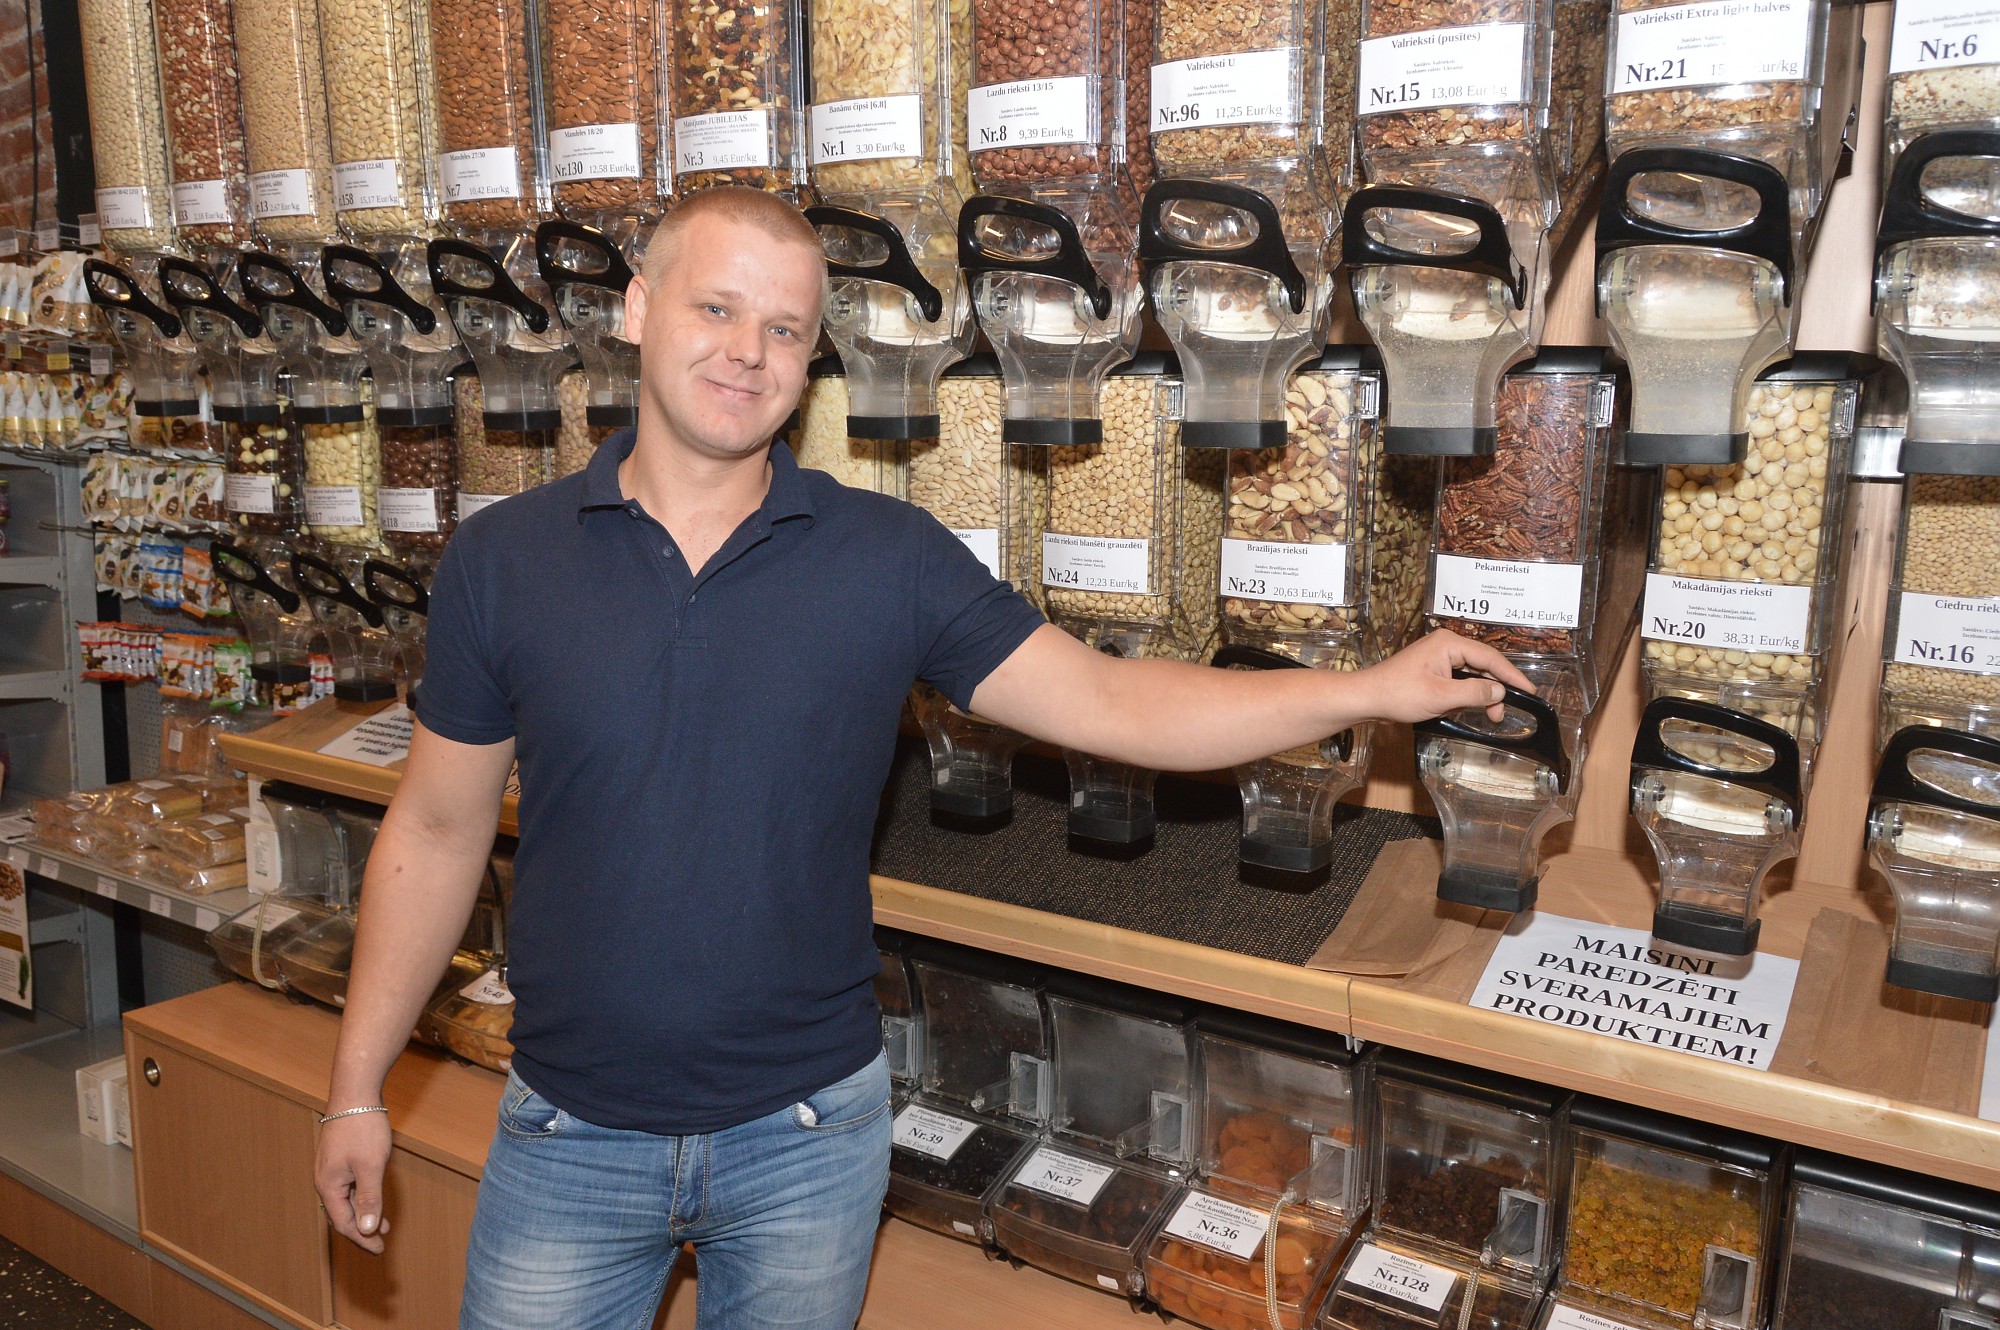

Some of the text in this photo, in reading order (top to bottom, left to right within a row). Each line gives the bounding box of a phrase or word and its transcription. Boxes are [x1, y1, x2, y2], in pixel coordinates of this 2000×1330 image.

[1633, 10, 1683, 26] Valrieksti
[1686, 7, 1719, 19] Extra
[1753, 1, 1791, 14] halves
[1391, 31, 1481, 49] Valrieksti (pusītes)
[1917, 34, 1978, 62] Nr.6
[1186, 58, 1235, 72] Valrieksti U
[1625, 58, 1687, 84] Nr.21
[1758, 59, 1798, 74] ur/kg
[987, 82, 1054, 98] Lazdu rieksti 13/15
[1369, 82, 1420, 107] Nr.15
[1431, 86, 1463, 100] 13,08
[829, 100, 887, 114] Banānu čipsi [6.8]
[1158, 103, 1282, 125] Nr.96 11,25 Eur/kg
[708, 114, 748, 124] JUBILEJAS
[564, 127, 603, 138] Mandeles 18/20
[980, 125, 1074, 144] Nr.8 9,39 Eur/kg
[821, 140, 906, 158] Nr.1 3,30 Eur/kg
[683, 151, 757, 167] Nr.3 9,45 Eur/kg
[554, 161, 636, 178] Nr.130 12,58 Eur/kg
[359, 196, 375, 205] 15,17
[376, 194, 398, 204] Eur/kg
[445, 184, 510, 197] Nr.7 10,42 Eur/kg
[281, 202, 300, 212] Eur/kg
[1060, 537, 1079, 546] rieksti
[1079, 538, 1106, 549] blanšēti
[1107, 540, 1143, 550] grauzdēti
[1247, 544, 1308, 555] Brazīlijas rieksti
[1475, 562, 1530, 574] Pekanrieksti
[1047, 567, 1139, 590] Nr.24 12,23 Eur/kg
[1227, 576, 1333, 601] Nr.23 20,63 Eur/kg
[1671, 580, 1773, 597] Makadāmijas rieksti
[1442, 594, 1573, 624] Nr.19 24,14 Eur/kg
[1935, 599, 1973, 611] Ciedru
[1652, 616, 1800, 650] Nr.20 38,31 Eur/kg
[1909, 639, 1975, 664] Nr.16
[1572, 934, 1719, 977] MAISIŅI
[1535, 952, 1740, 1006] PAREDZĒTI
[1499, 970, 1772, 1040] SVERAMAJIEM
[1490, 992, 1759, 1066] PRODUKTIEM!
[897, 1127, 944, 1154] Nr.39 3,26 Eur/kg
[1032, 1170, 1082, 1198] Nr.37 6,52 Eur/kg
[1194, 1201, 1206, 1209] bez
[1200, 1196, 1259, 1219] Aprikozes žāvētas
[1185, 1219, 1240, 1251] Nr.36 5,86 Eur/kg
[1390, 1255, 1417, 1267] Rozīnes
[1367, 1266, 1430, 1302] Nr.128 2,03 Eur/kg
[1578, 1314, 1611, 1328] Rozīnes
